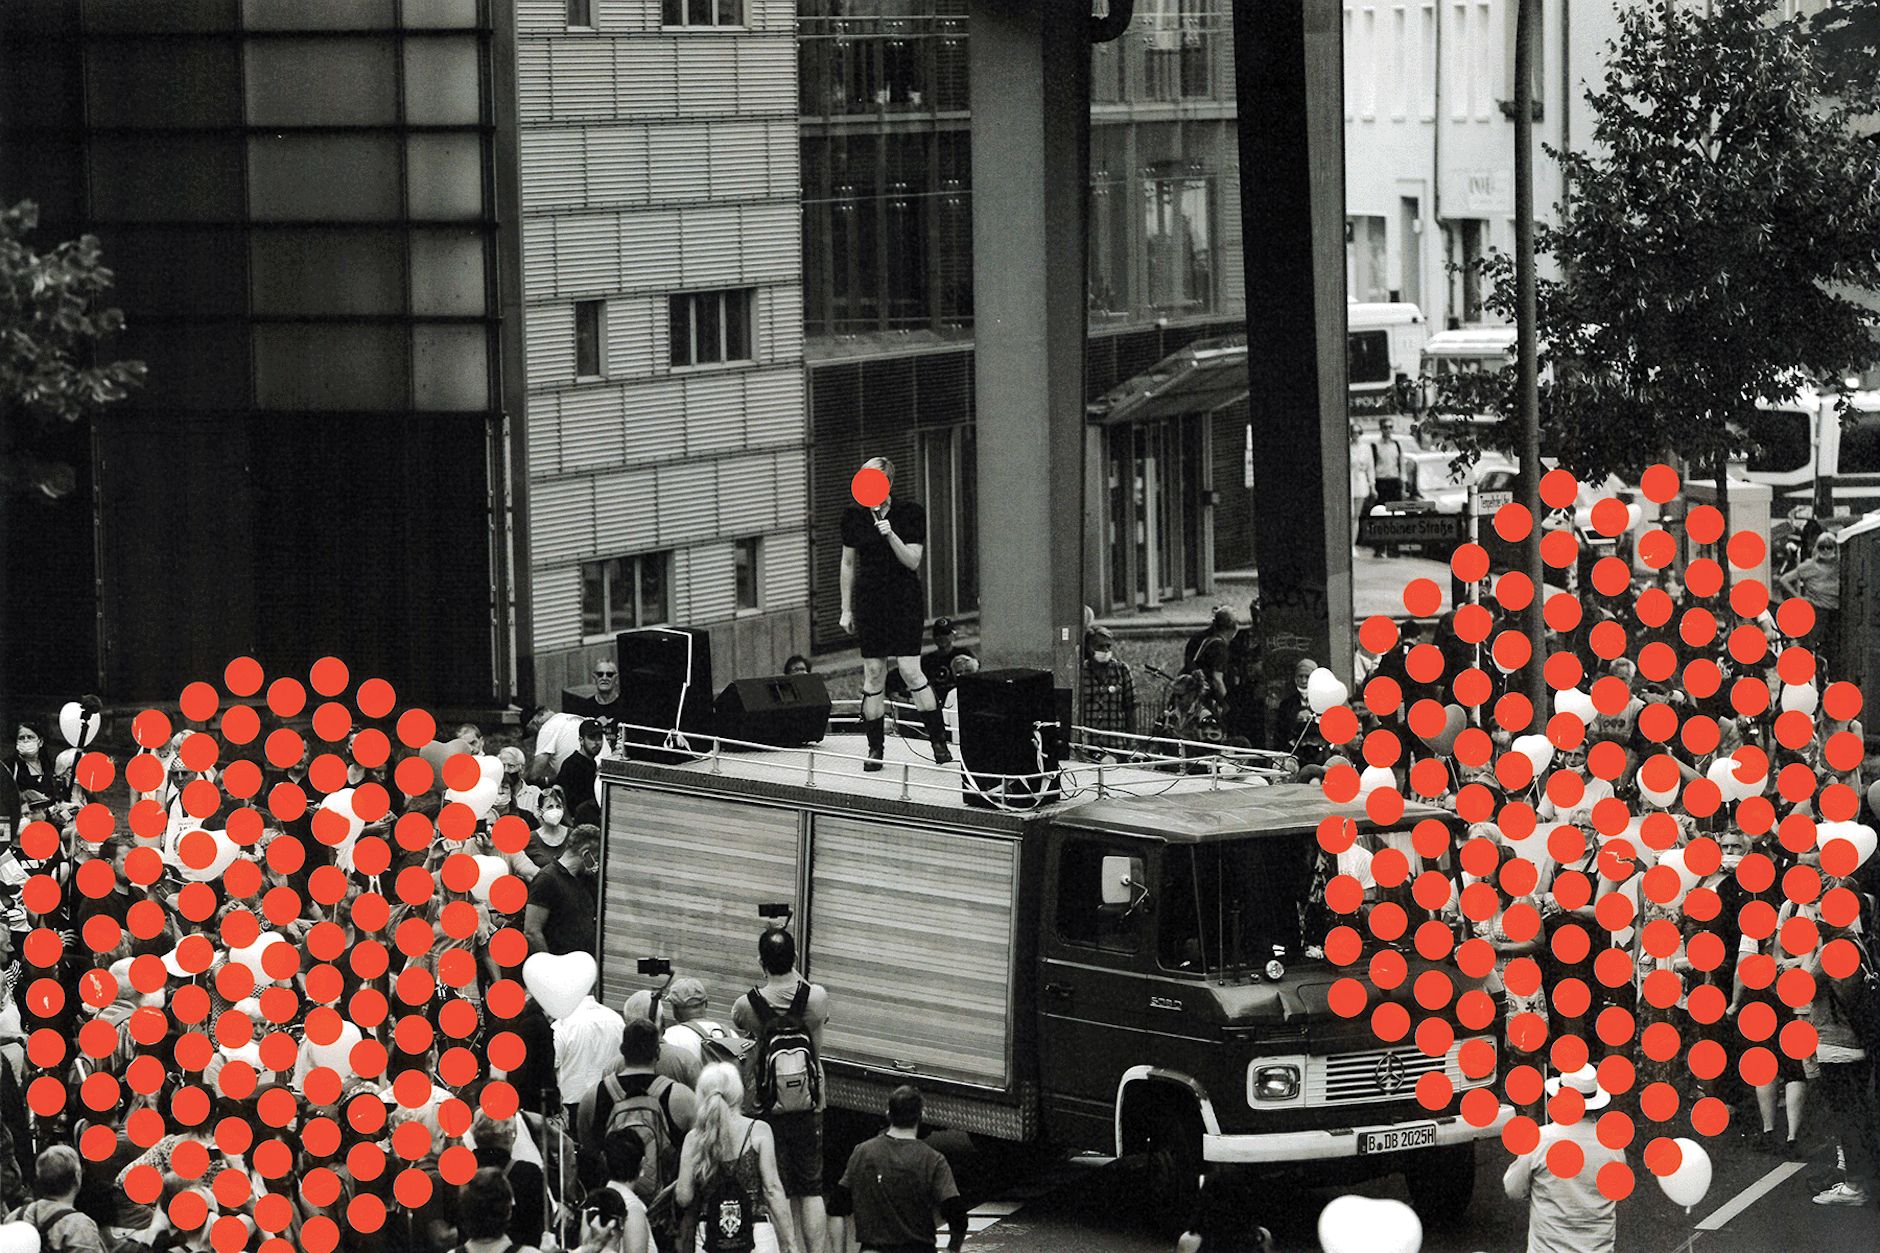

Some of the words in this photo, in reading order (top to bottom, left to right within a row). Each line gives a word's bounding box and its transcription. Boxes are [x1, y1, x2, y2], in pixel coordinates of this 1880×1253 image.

[1368, 521, 1416, 535] Trebbiner
[1418, 520, 1454, 536] Straße
[1384, 1133, 1398, 1149] DB
[1401, 1128, 1434, 1147] 2025H
